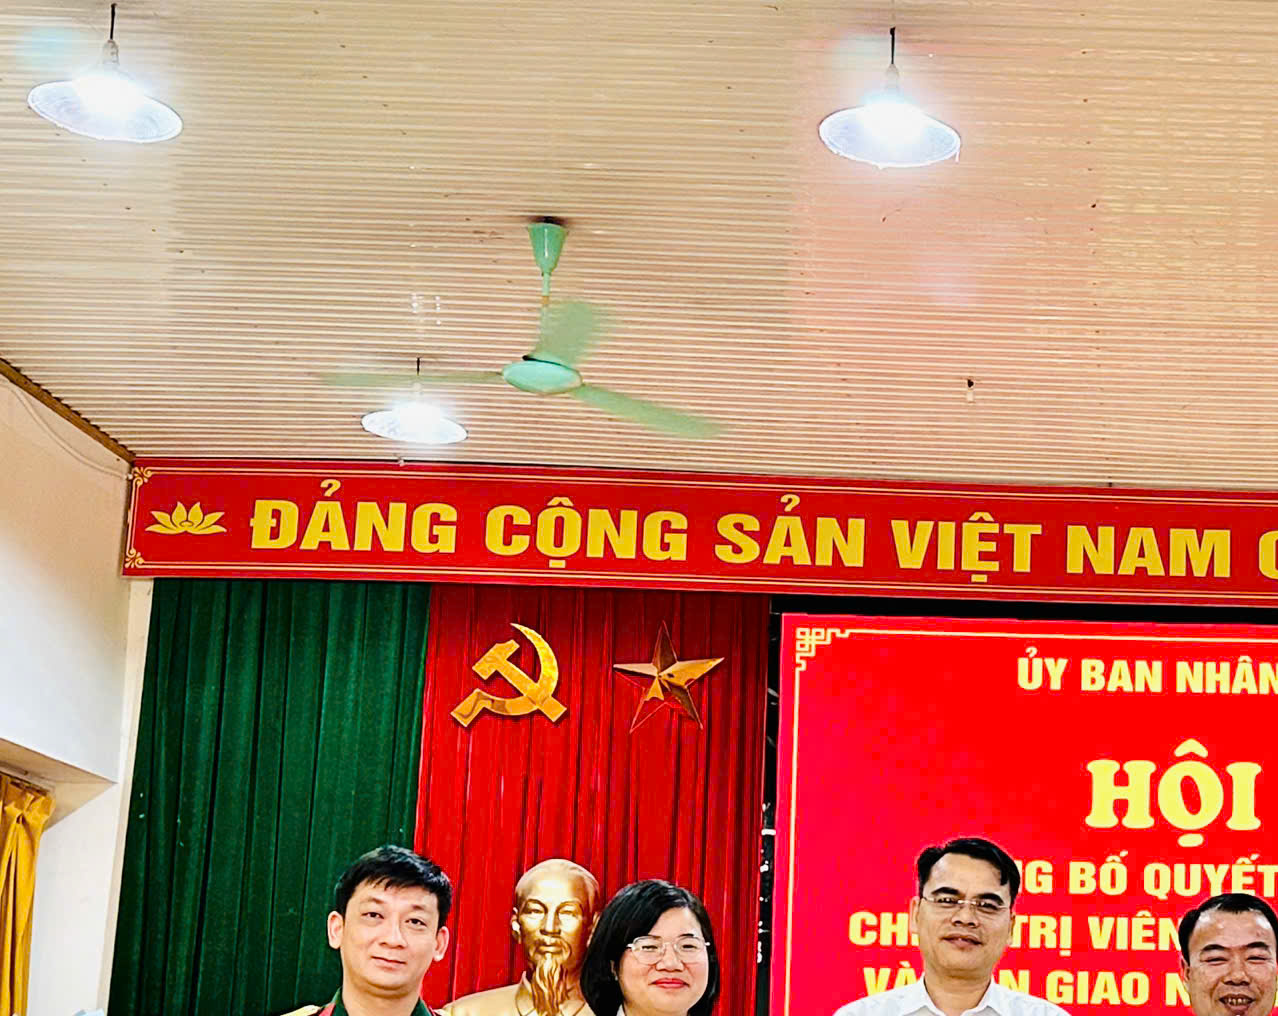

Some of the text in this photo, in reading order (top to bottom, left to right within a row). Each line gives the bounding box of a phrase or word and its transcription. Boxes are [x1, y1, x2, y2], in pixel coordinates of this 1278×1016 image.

[250, 478, 457, 554] ĐẢNG
[484, 496, 687, 568] CỘNG
[714, 493, 867, 567] SẢN
[891, 511, 1042, 583] VIỆT
[1066, 525, 1231, 578] NAM
[1017, 647, 1068, 690] ỦY
[1080, 658, 1163, 693] BAN
[1084, 738, 1262, 848] HỘI
[1068, 850, 1129, 896] BỐ
[1045, 970, 1150, 1005] GIAO
